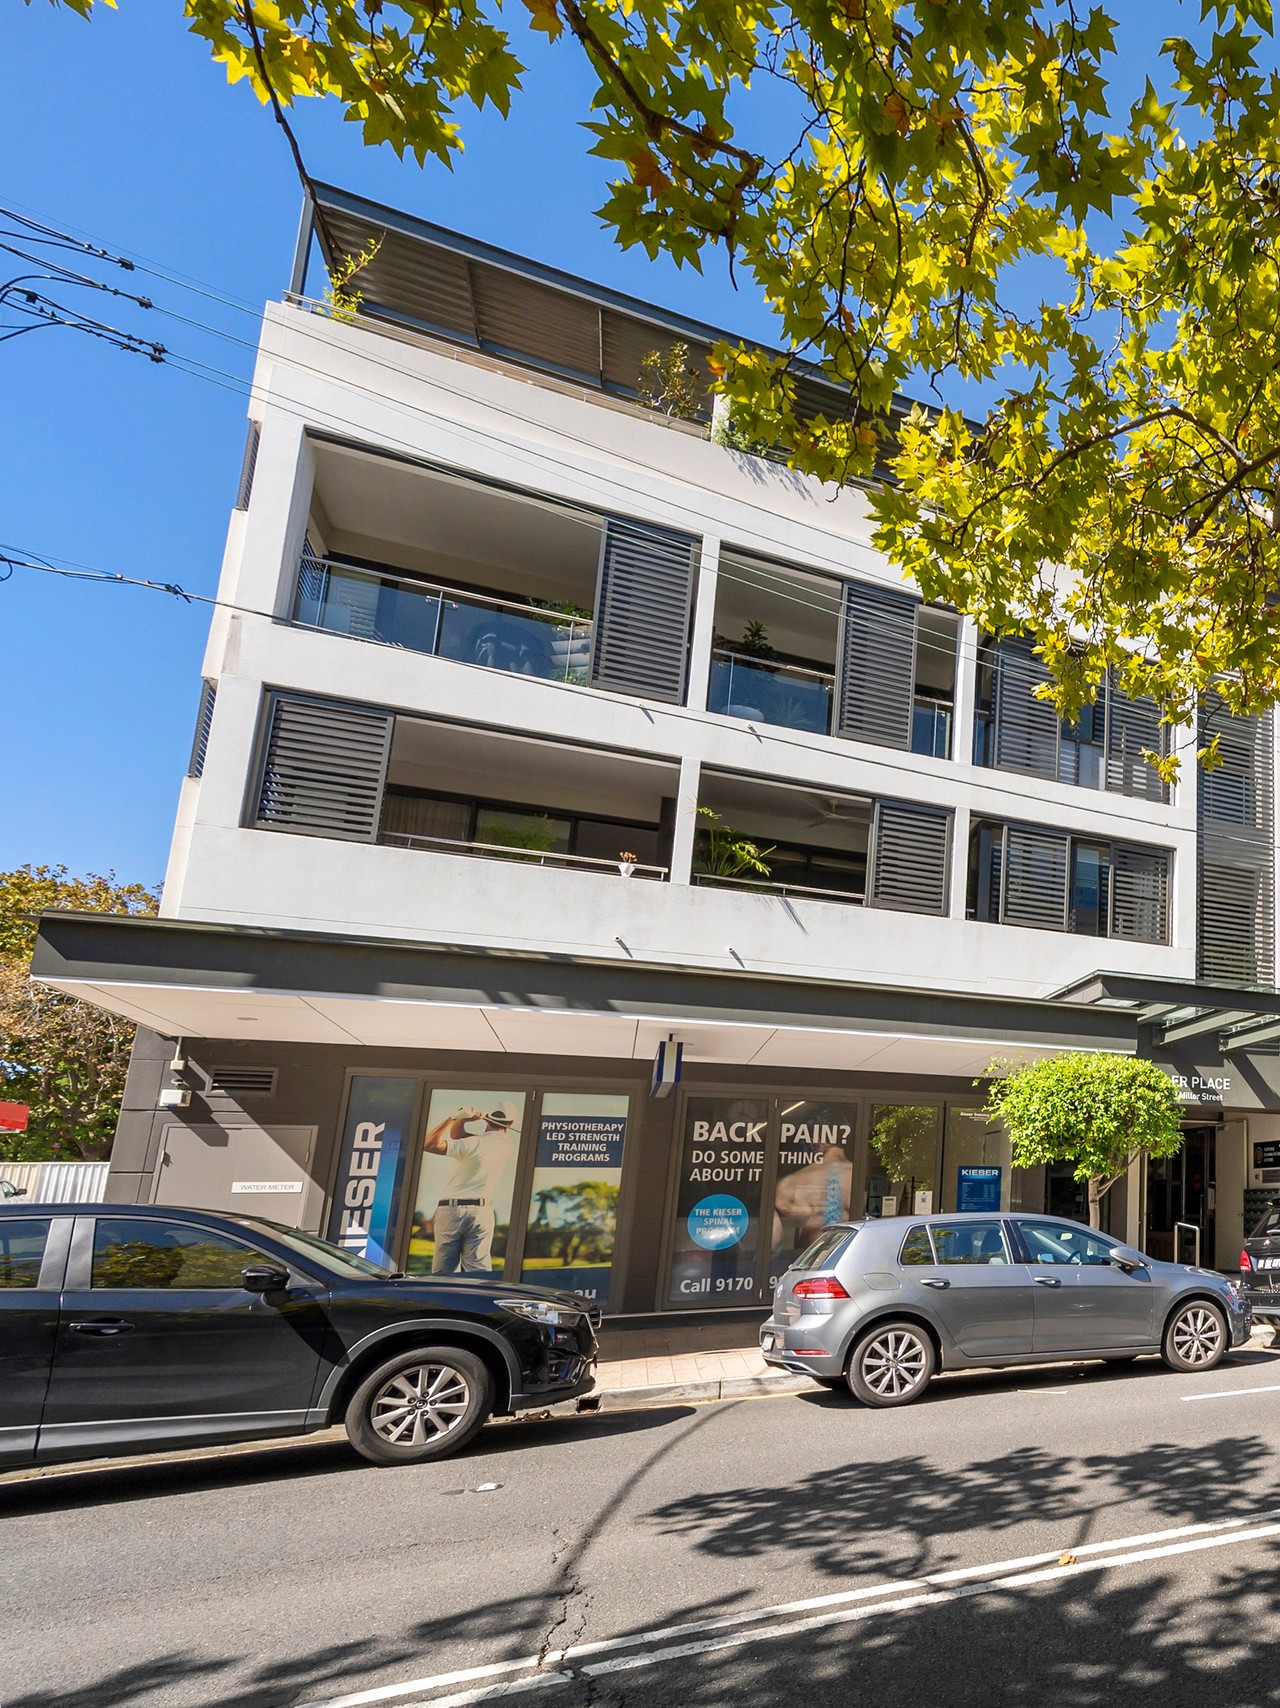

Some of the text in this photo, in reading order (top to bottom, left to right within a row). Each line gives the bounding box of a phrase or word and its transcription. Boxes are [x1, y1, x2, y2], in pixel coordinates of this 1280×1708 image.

[1191, 1076, 1231, 1090] PLACE
[1179, 1091, 1224, 1102] Miller Street
[541, 1121, 625, 1132] PHYSIOTHERAPY
[546, 1132, 620, 1142] LED STRENGTH
[692, 1120, 851, 1145] BACK PAIN?
[557, 1142, 607, 1152] TRAINING
[551, 1153, 611, 1162] PROGRAMS
[691, 1150, 824, 1165] DO SOME THING
[689, 1168, 763, 1182] ABOUT IT
[962, 1169, 999, 1177] KIESER
[695, 1208, 743, 1216] THE KIESER
[703, 1217, 734, 1226] SPINAL
[680, 1278, 711, 1294] Call
[715, 1276, 754, 1292] 9170
